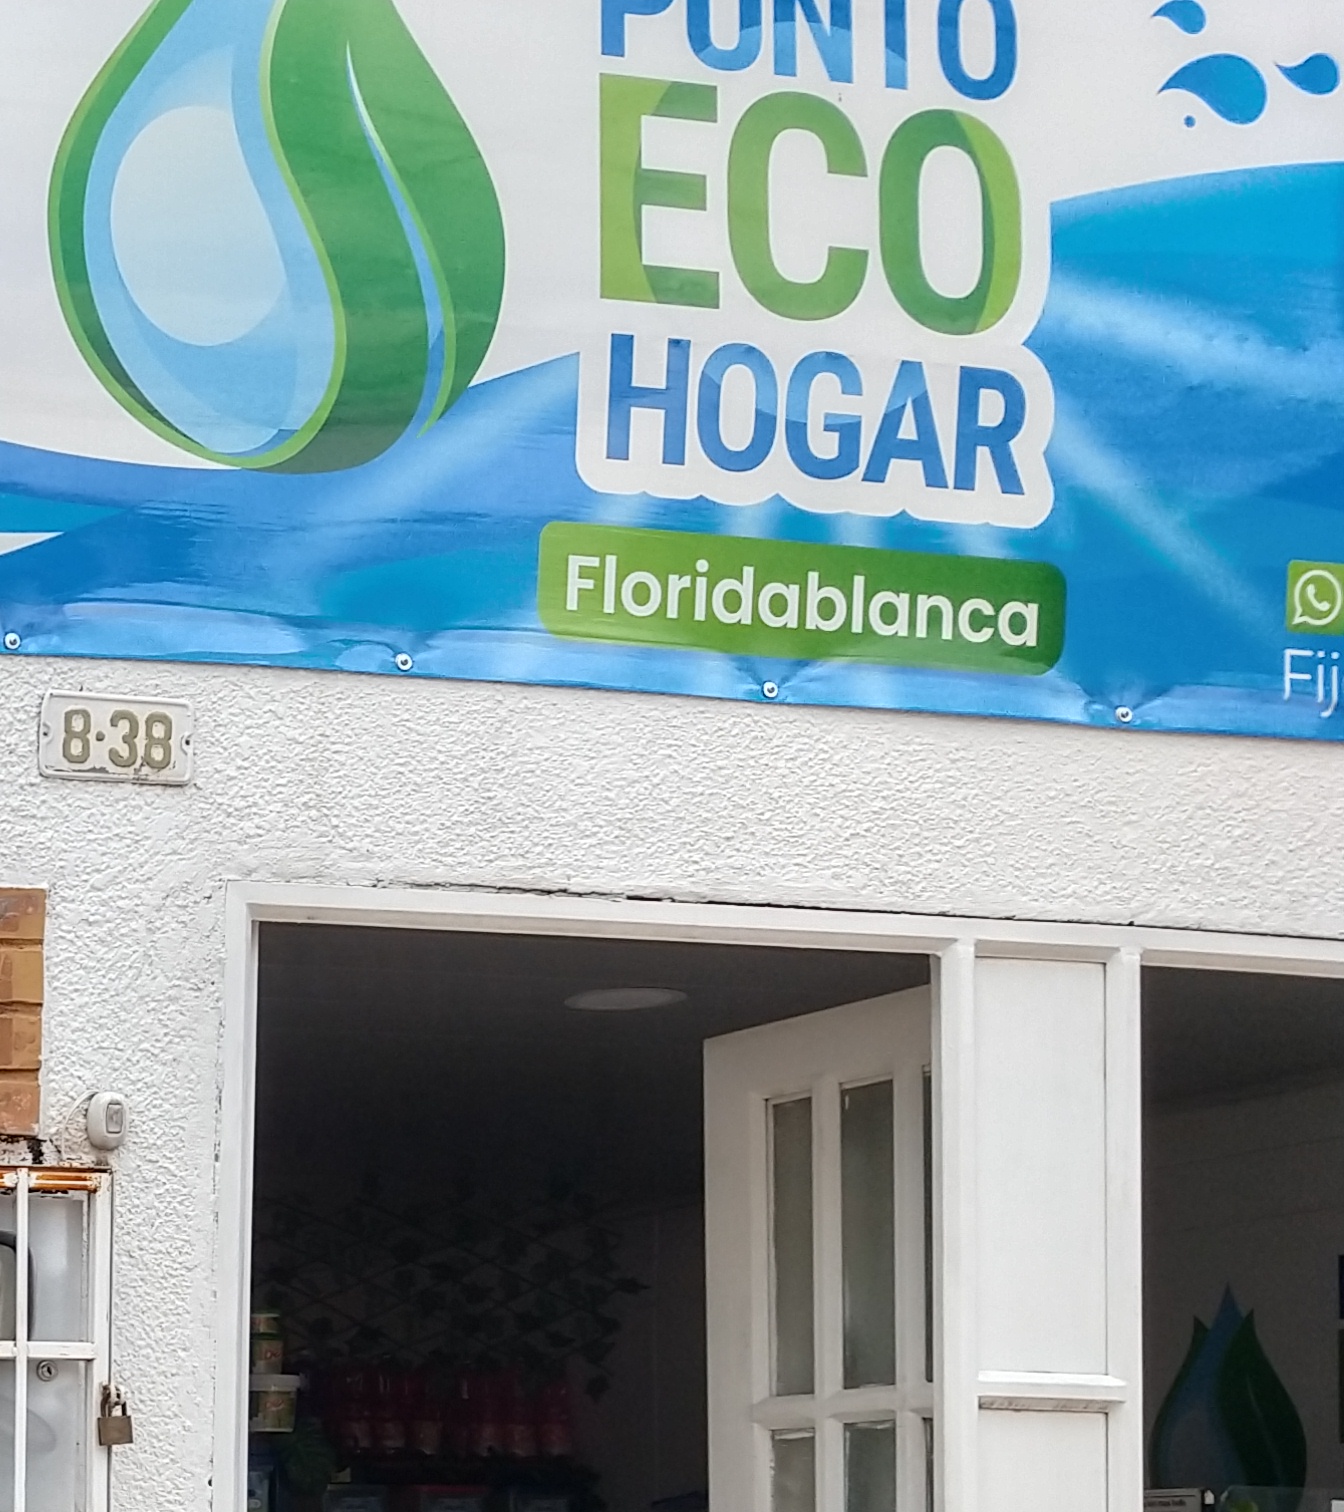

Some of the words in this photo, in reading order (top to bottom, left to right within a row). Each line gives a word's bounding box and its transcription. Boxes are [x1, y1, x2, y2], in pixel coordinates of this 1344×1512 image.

[599, 72, 1022, 336] ECO
[605, 332, 1027, 496] HOGAR
[563, 553, 1041, 648] Floridablanca
[1283, 648, 1344, 719] Fij
